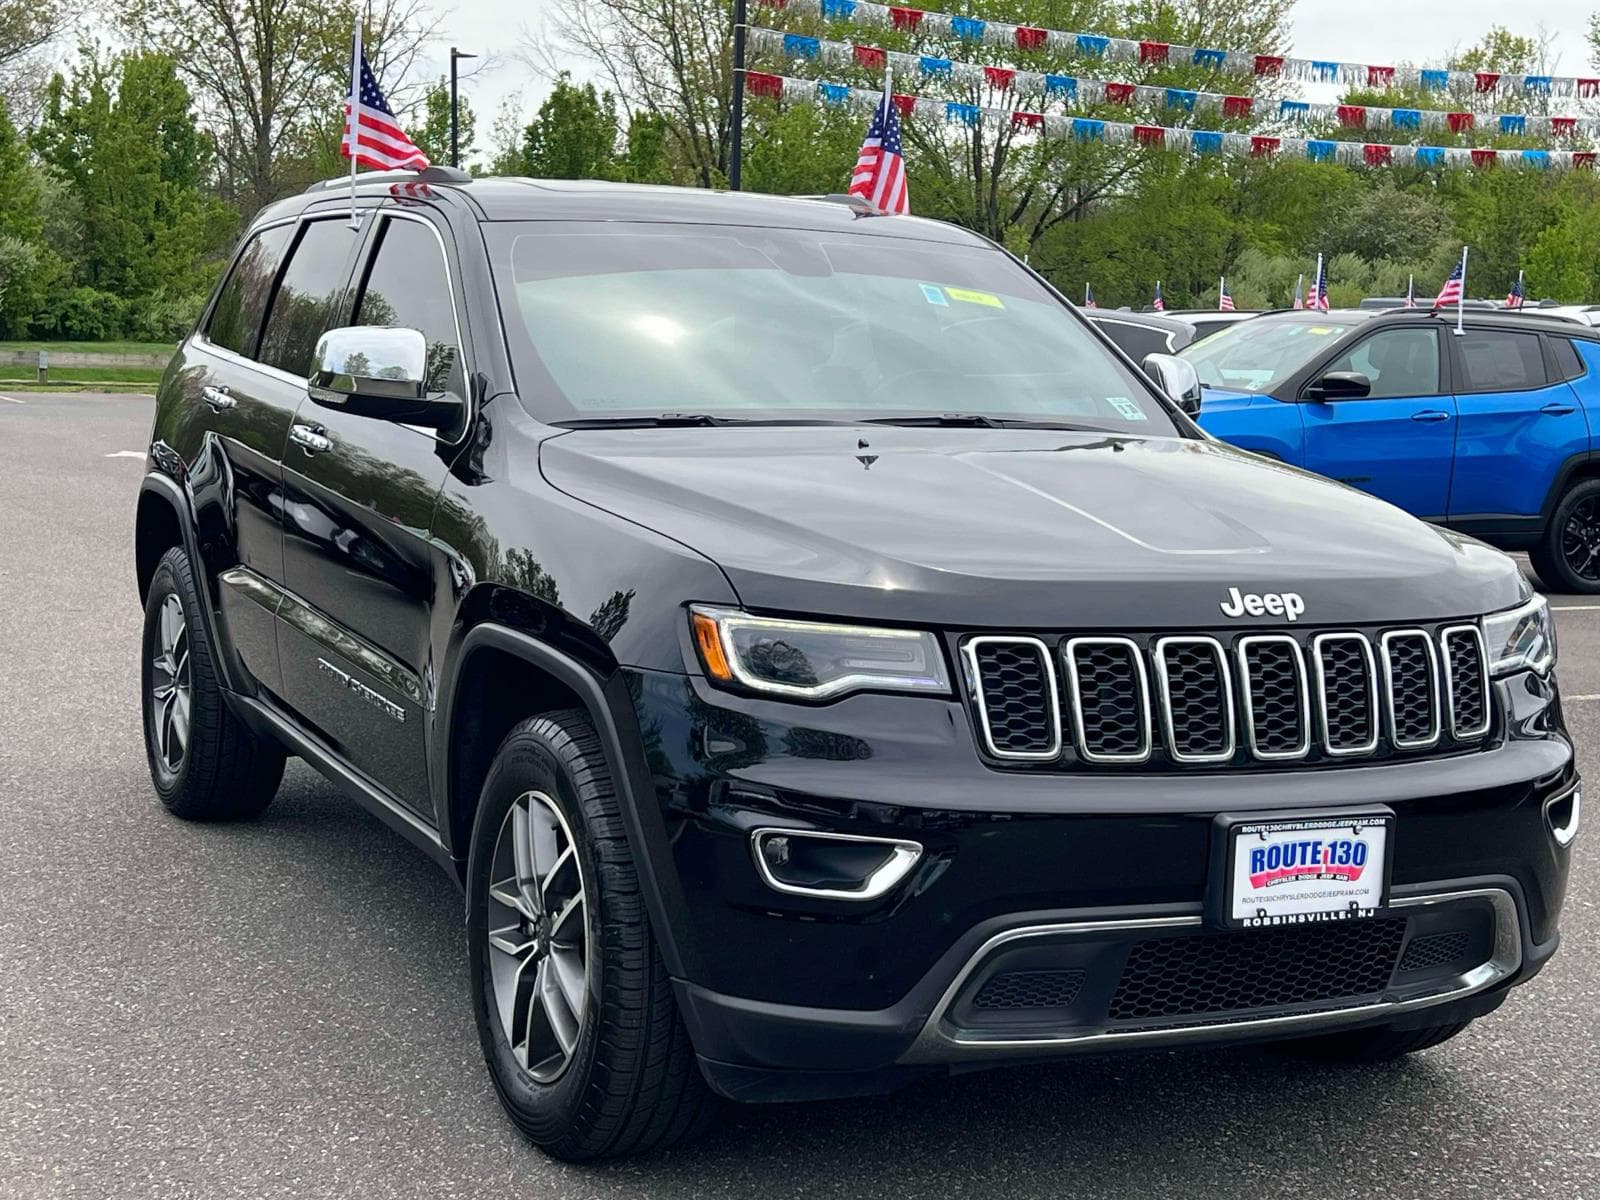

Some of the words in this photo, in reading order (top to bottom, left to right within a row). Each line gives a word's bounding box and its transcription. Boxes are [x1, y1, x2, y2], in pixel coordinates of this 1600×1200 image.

[1220, 587, 1305, 621] Jeep
[1242, 819, 1386, 833] ROUTE130CHRYSLERDODGEJEEPRAM.COM
[1251, 841, 1323, 874] ROUTE
[1328, 840, 1367, 866] 130
[1267, 875, 1296, 887] CHRYSLER
[1358, 908, 1375, 918] NJ
